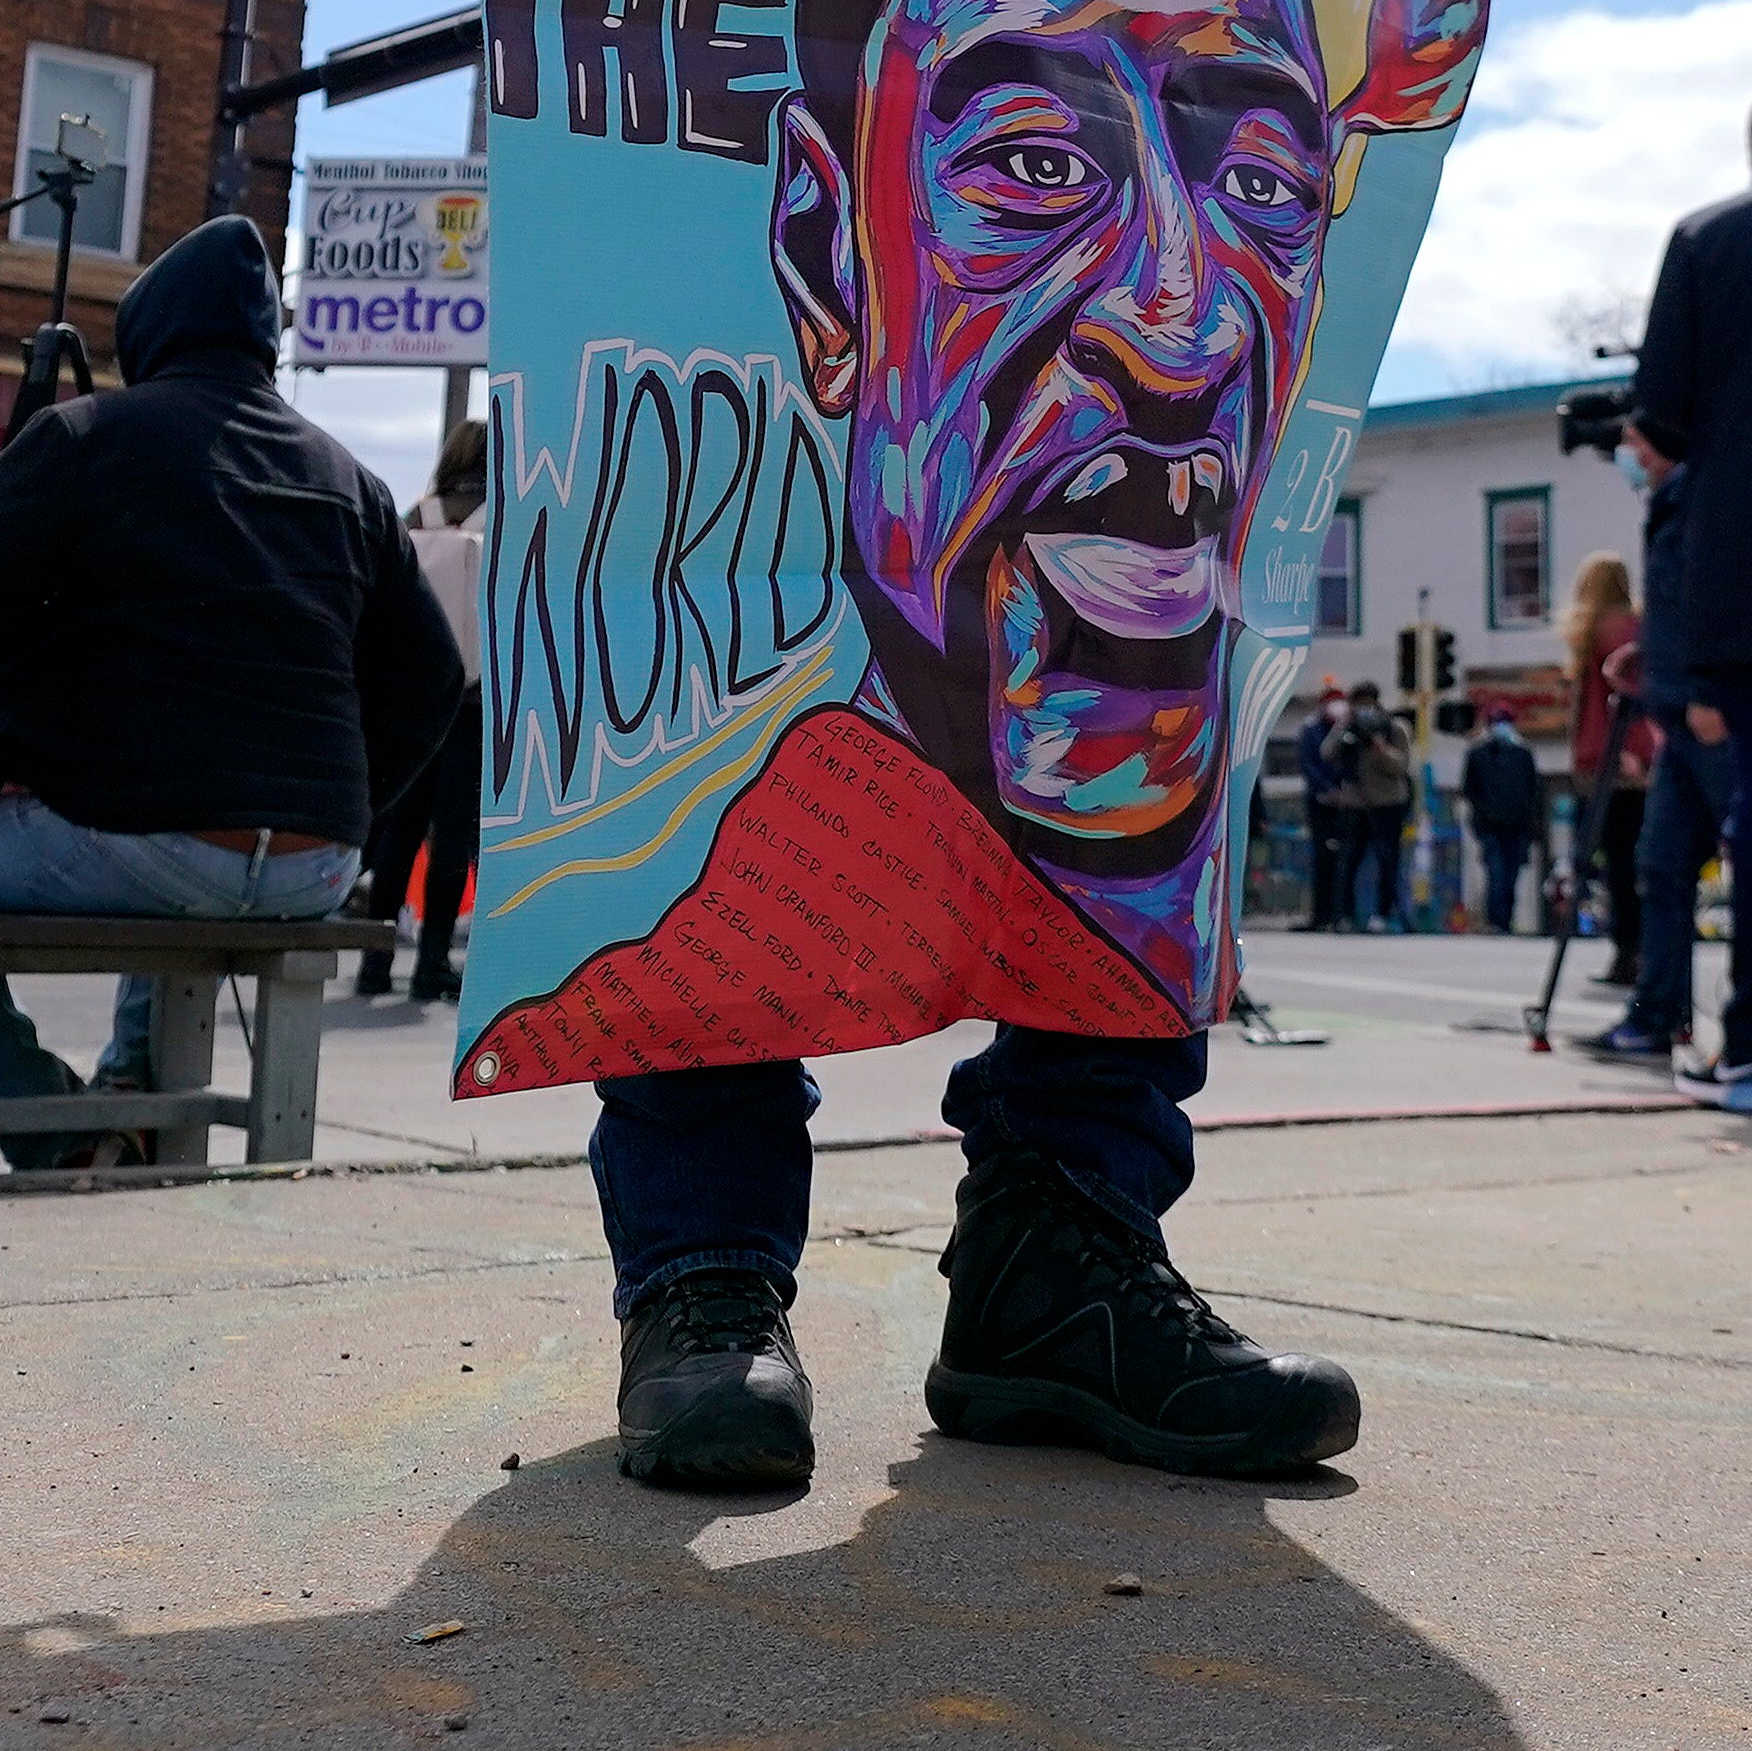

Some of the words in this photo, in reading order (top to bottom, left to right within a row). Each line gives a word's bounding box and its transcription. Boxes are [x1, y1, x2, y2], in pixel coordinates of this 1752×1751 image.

[304, 234, 421, 273] Foods
[317, 190, 417, 240] Cup
[435, 208, 478, 231] DELI
[303, 286, 485, 349] metro
[487, 356, 839, 808] WORLD
[767, 771, 850, 839] PHILANDO
[795, 728, 859, 788] TAMIR
[862, 779, 900, 819] RICE
[720, 847, 774, 894] JOHN
[736, 808, 822, 877] WALTER
[831, 872, 890, 918] SCOTT
[824, 716, 902, 774] GEORGE
[1013, 875, 1086, 951] TAYLOR
[701, 890, 758, 942] EZELL
[762, 933, 802, 972] FORD
[592, 961, 666, 1038] MATTHEW
[636, 944, 723, 1033] MICHELLE
[673, 921, 747, 984] GEORGE
[752, 984, 805, 1031] MANN
[545, 1000, 589, 1059] TONY
